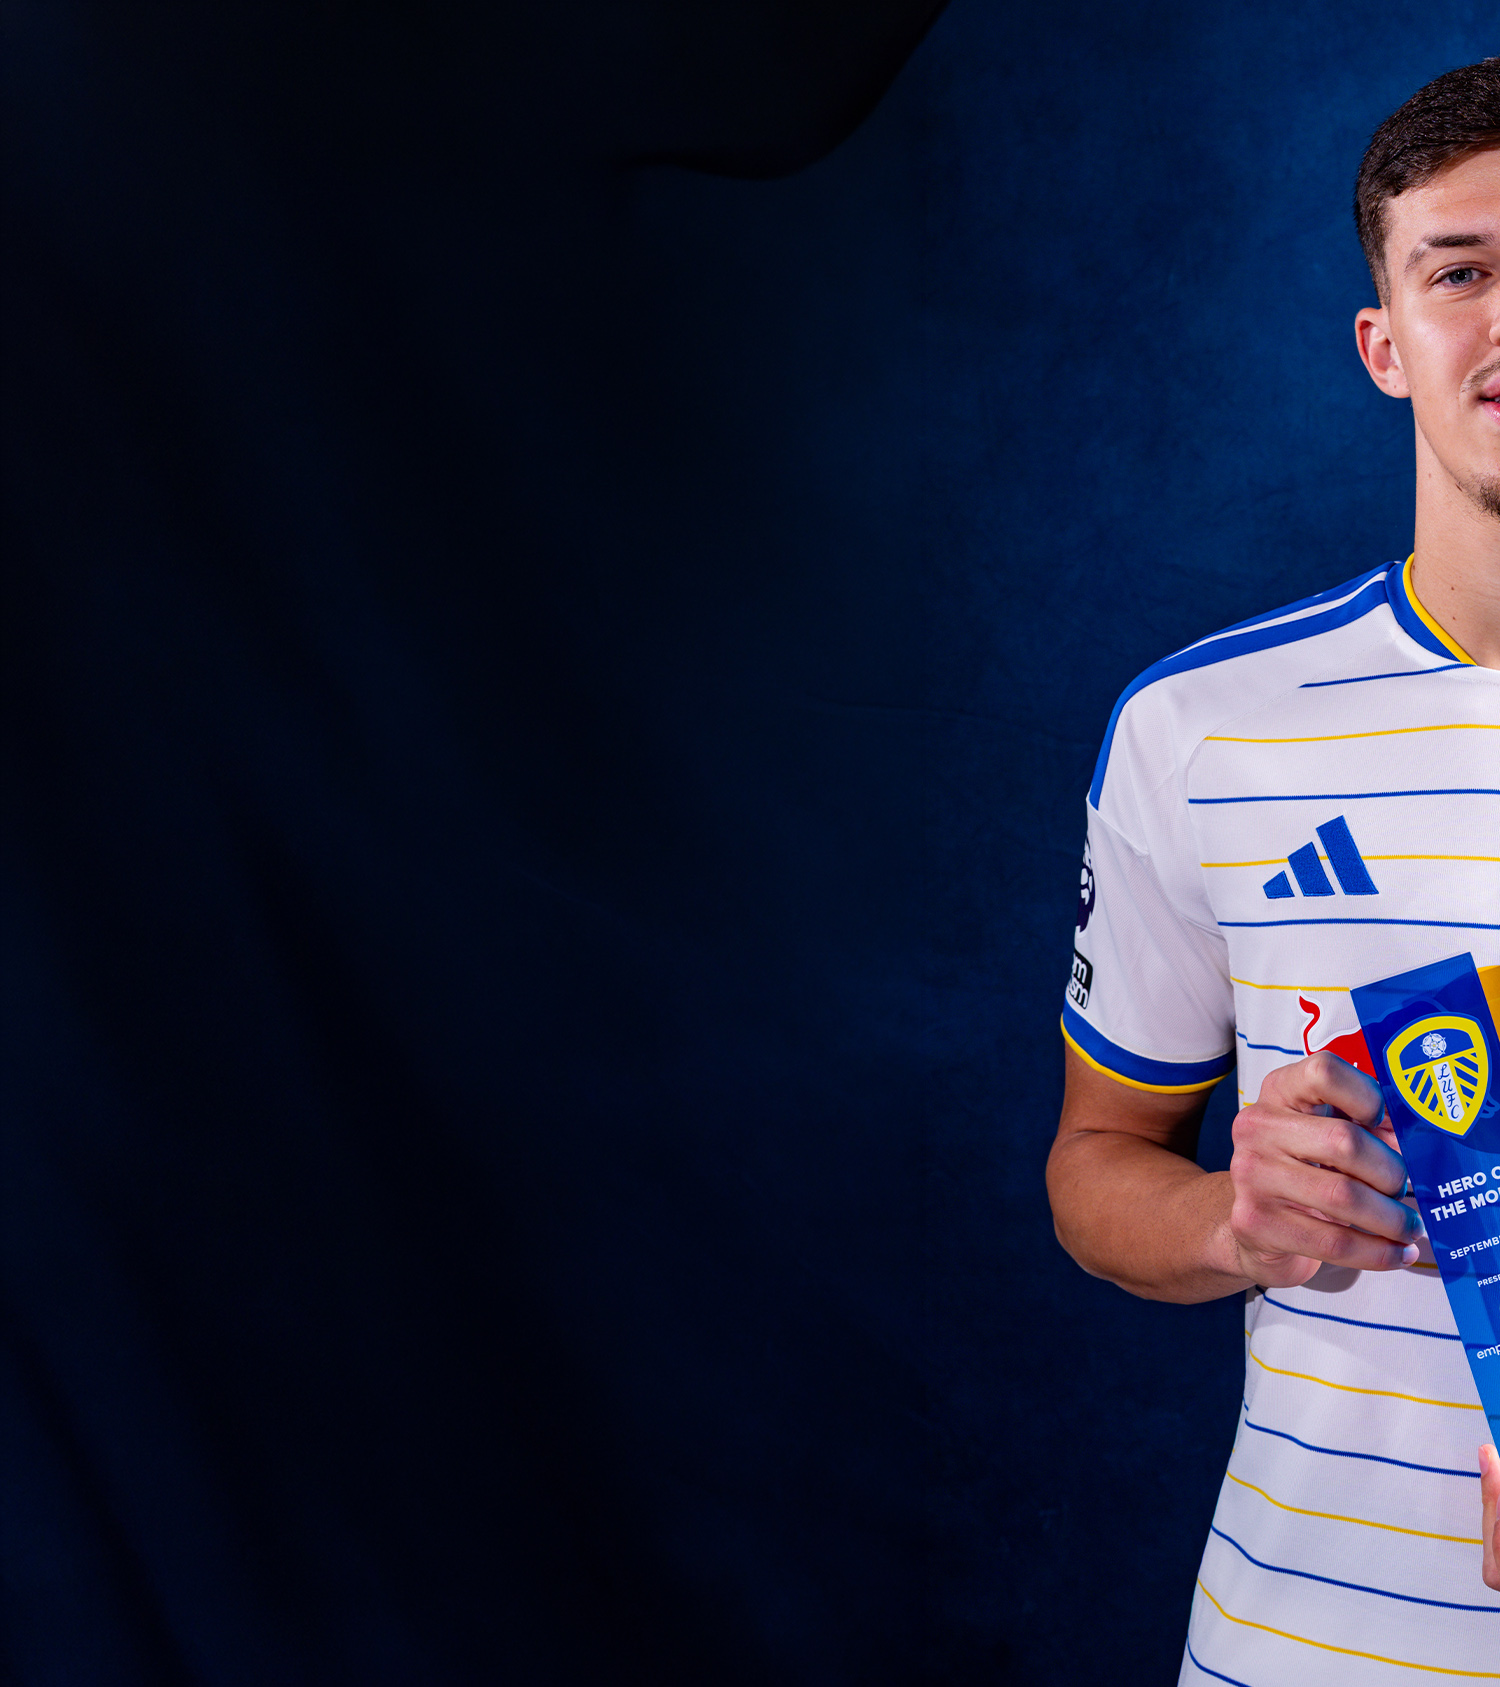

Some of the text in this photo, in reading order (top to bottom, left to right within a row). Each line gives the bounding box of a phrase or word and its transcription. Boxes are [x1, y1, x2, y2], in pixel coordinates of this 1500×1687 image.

[1438, 1063, 1460, 1119] LUFC
[1438, 1171, 1487, 1198] HERO
[1430, 1199, 1467, 1221] THE
